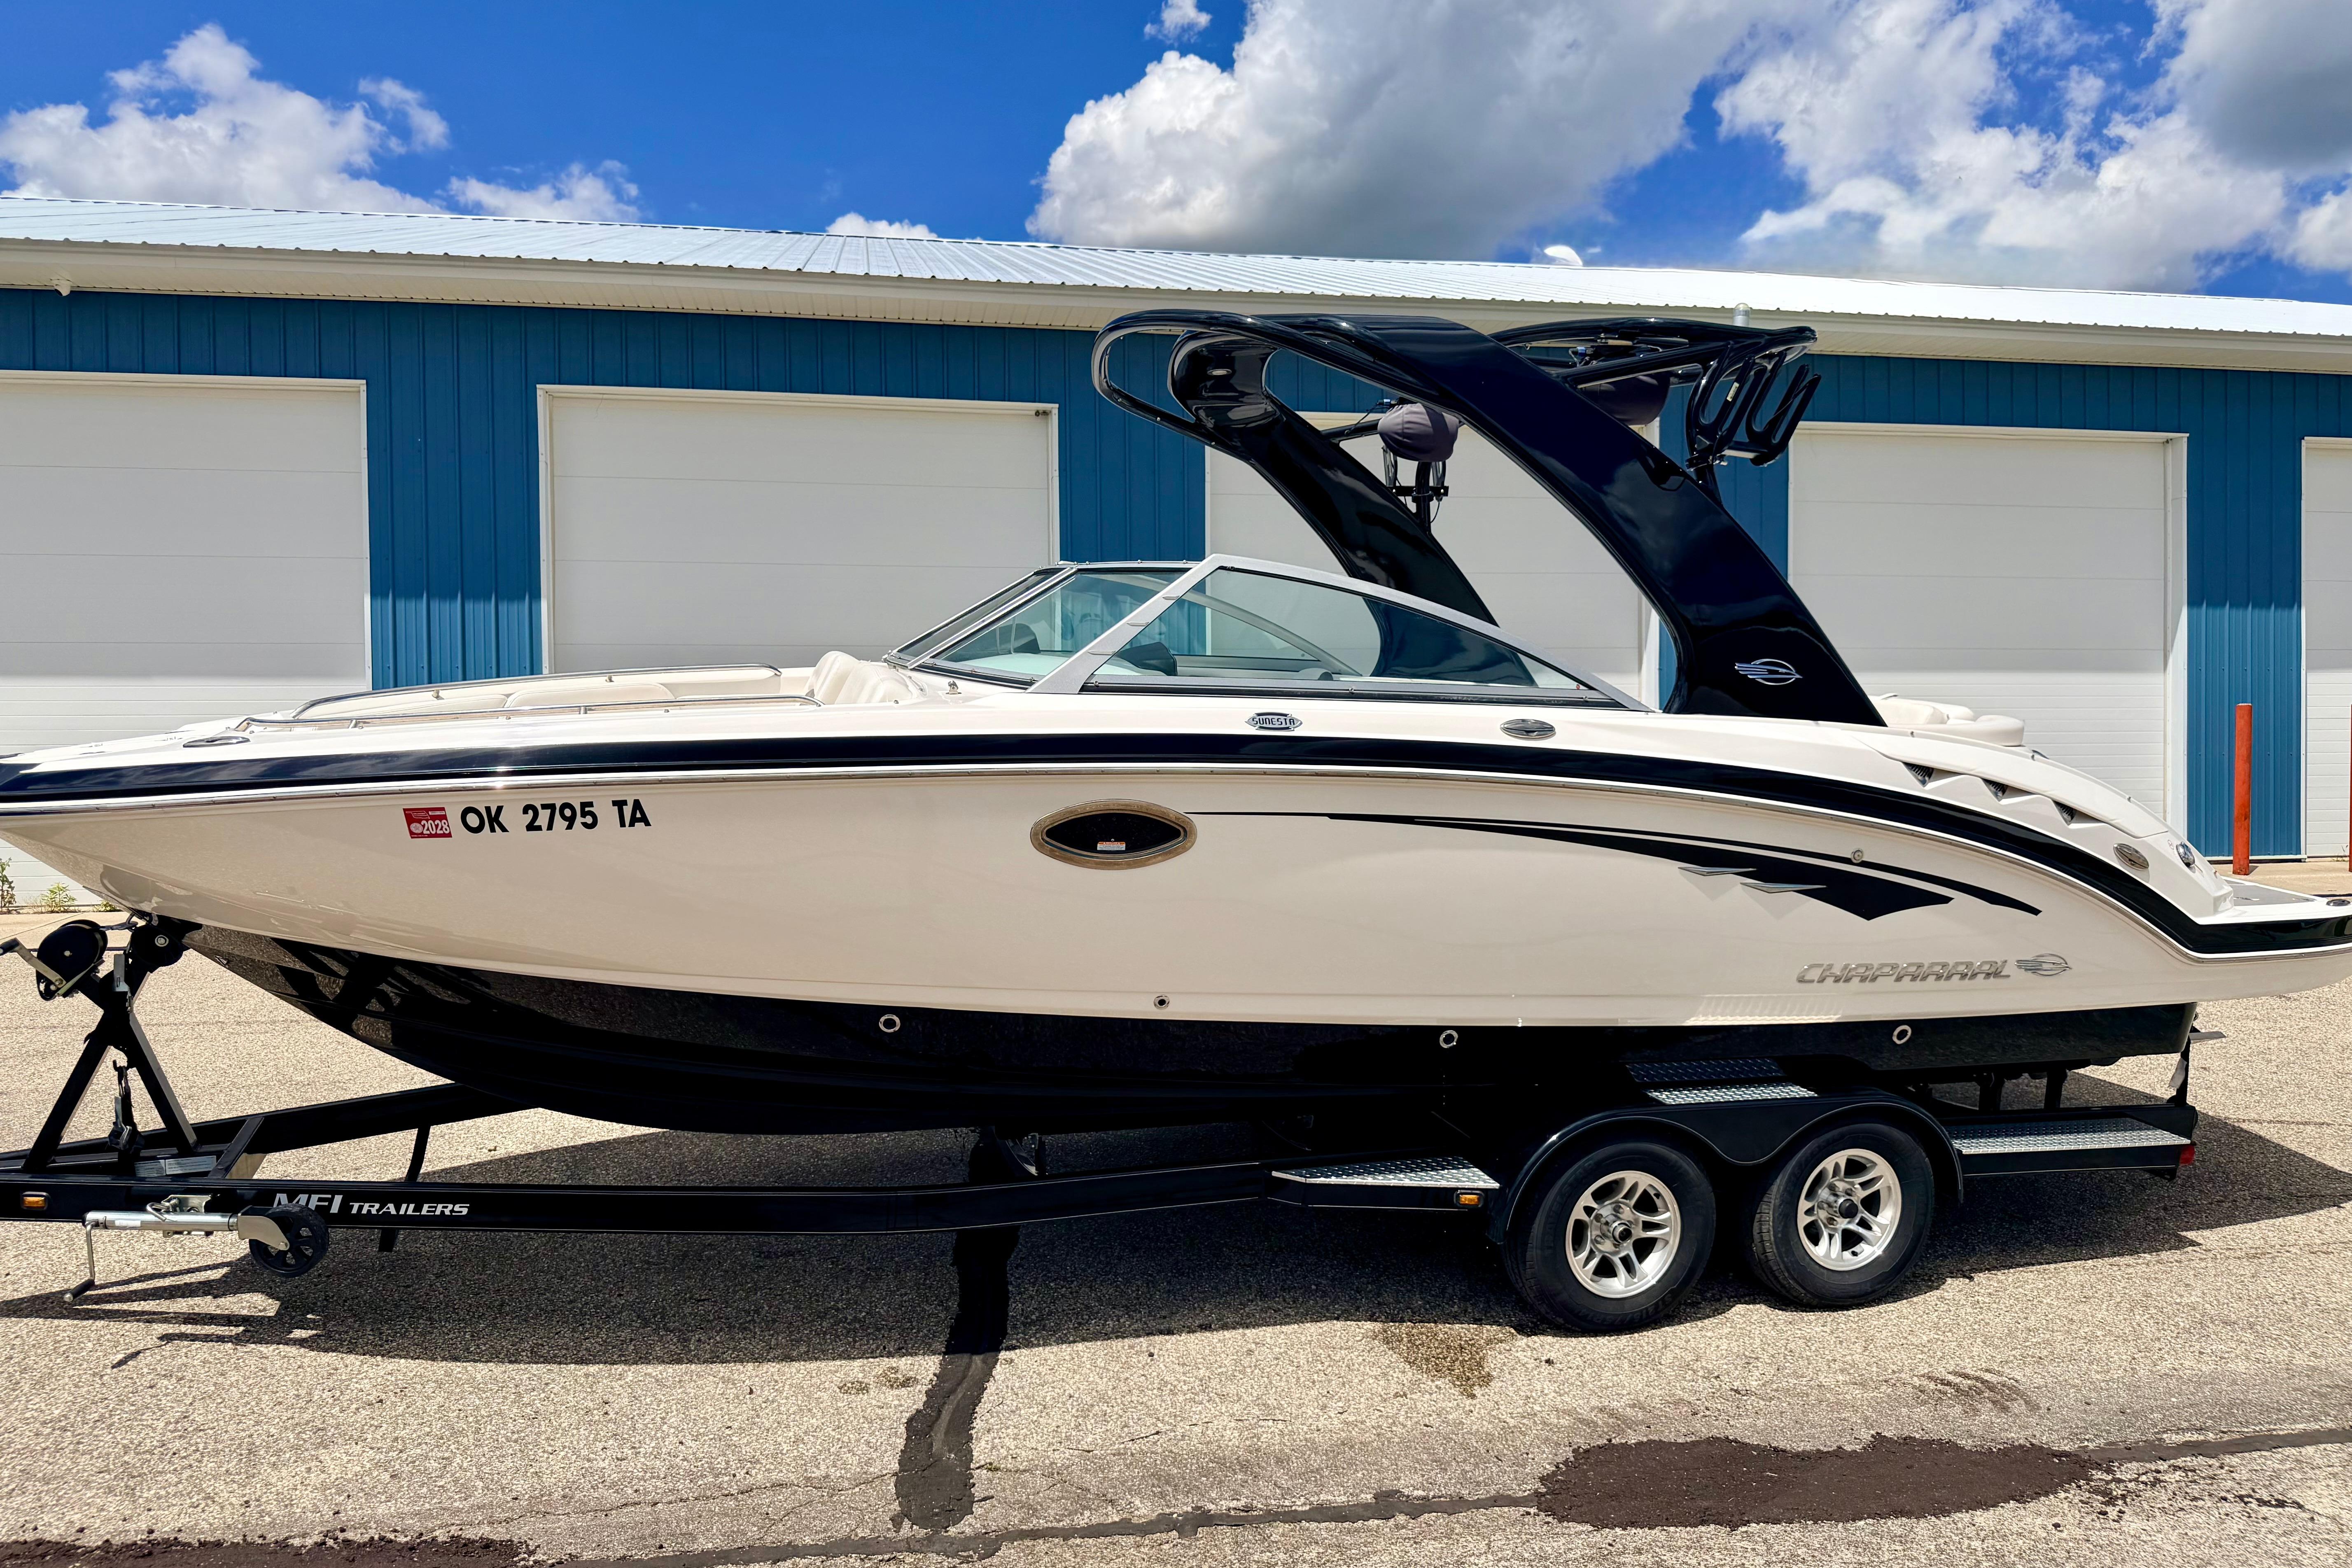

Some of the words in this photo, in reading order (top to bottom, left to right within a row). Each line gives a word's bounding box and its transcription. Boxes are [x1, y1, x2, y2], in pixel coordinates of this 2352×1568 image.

[1252, 717, 1295, 726] SUNESTA
[460, 805, 509, 834] OK
[522, 801, 598, 832] 2795
[611, 799, 652, 828] TA
[421, 819, 450, 834] 2028
[1796, 959, 2010, 983] CHAPARRAL
[350, 1202, 470, 1215] TRAILERS
